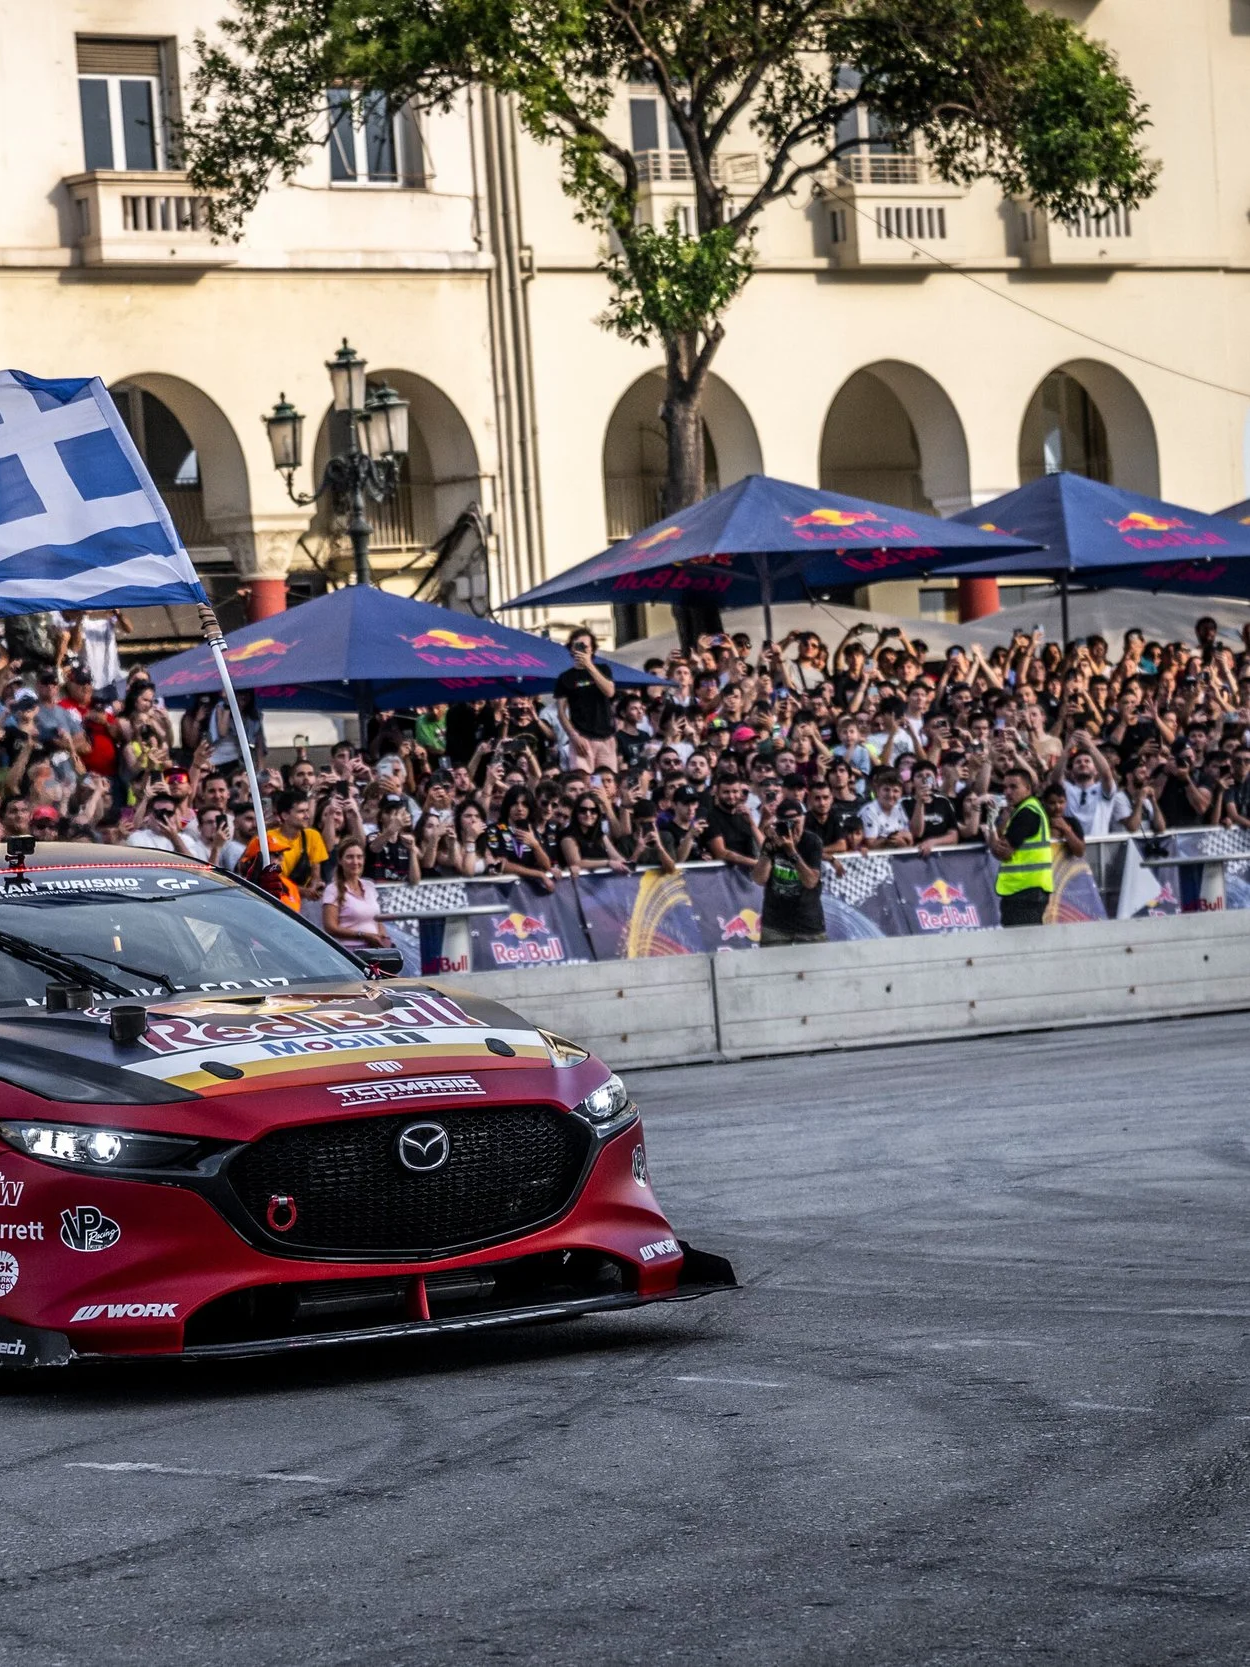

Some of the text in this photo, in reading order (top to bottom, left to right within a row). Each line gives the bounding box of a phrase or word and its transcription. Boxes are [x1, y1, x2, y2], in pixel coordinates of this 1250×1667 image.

[42, 878, 139, 891] TURISMO
[916, 905, 980, 929] Red Bull
[491, 941, 527, 964] Red
[528, 937, 565, 963] Bull
[138, 995, 491, 1055] Red Bull
[259, 1033, 384, 1057] Mobil
[60, 1206, 102, 1250] VP
[88, 1228, 119, 1246] Racing
[107, 1303, 179, 1318] WORK
